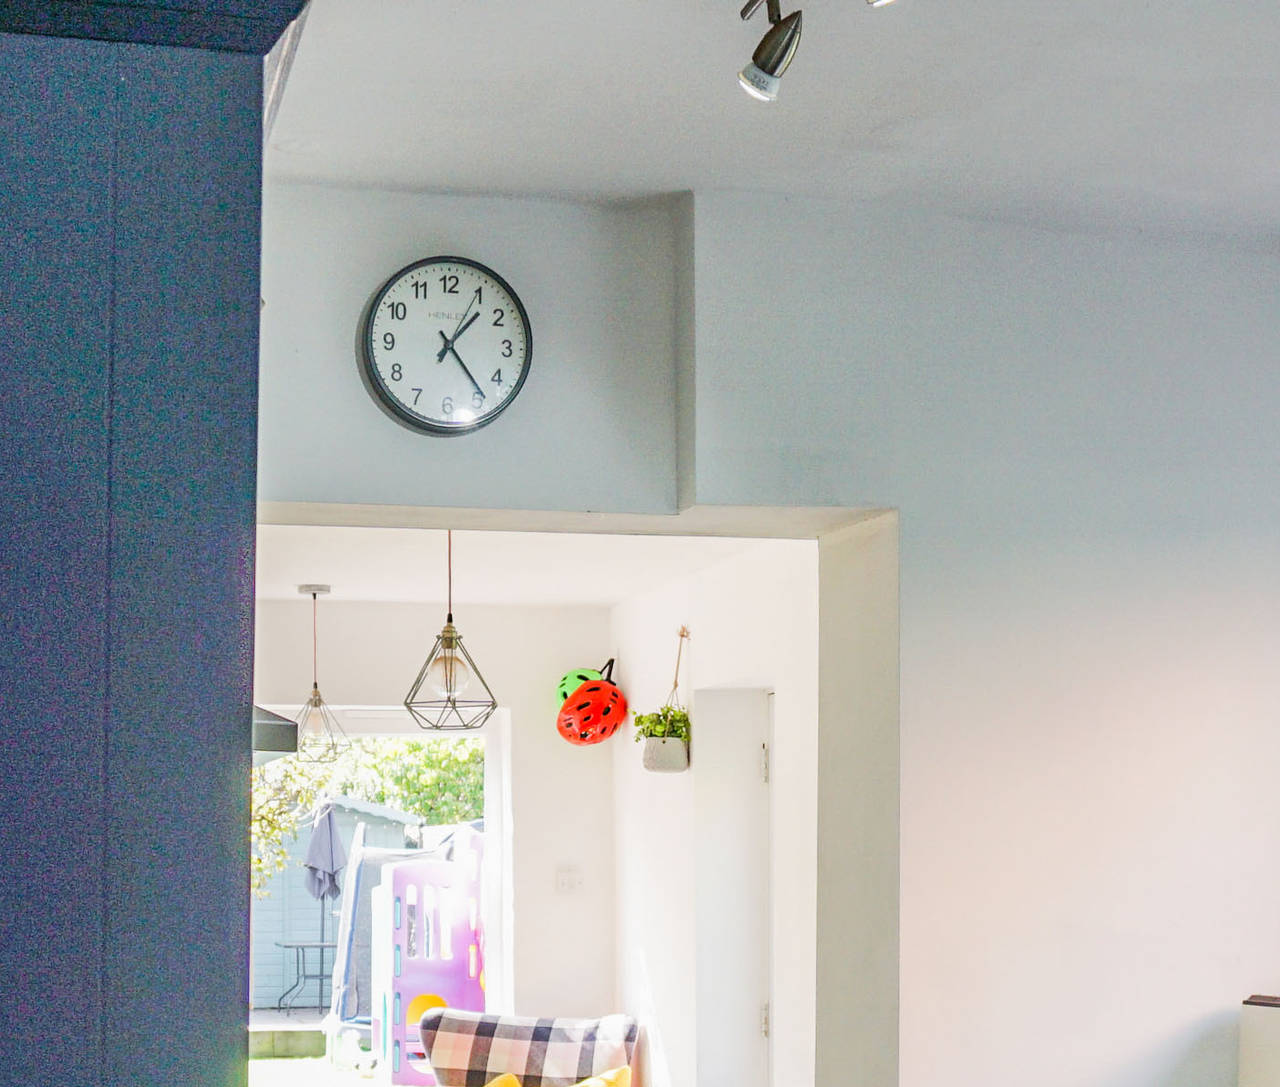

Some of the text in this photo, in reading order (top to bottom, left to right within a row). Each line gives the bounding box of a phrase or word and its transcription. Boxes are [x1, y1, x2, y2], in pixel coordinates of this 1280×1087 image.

[411, 281, 427, 299] 11
[439, 275, 459, 294] 12
[474, 286, 482, 304] 1
[387, 302, 407, 321] 10
[492, 308, 504, 327] 2
[383, 332, 395, 351] 9
[501, 339, 513, 358] 3
[391, 363, 403, 381] 8
[491, 368, 503, 386] 4
[411, 388, 423, 405] 7
[442, 396, 454, 415] 6
[472, 391, 484, 409] 5
